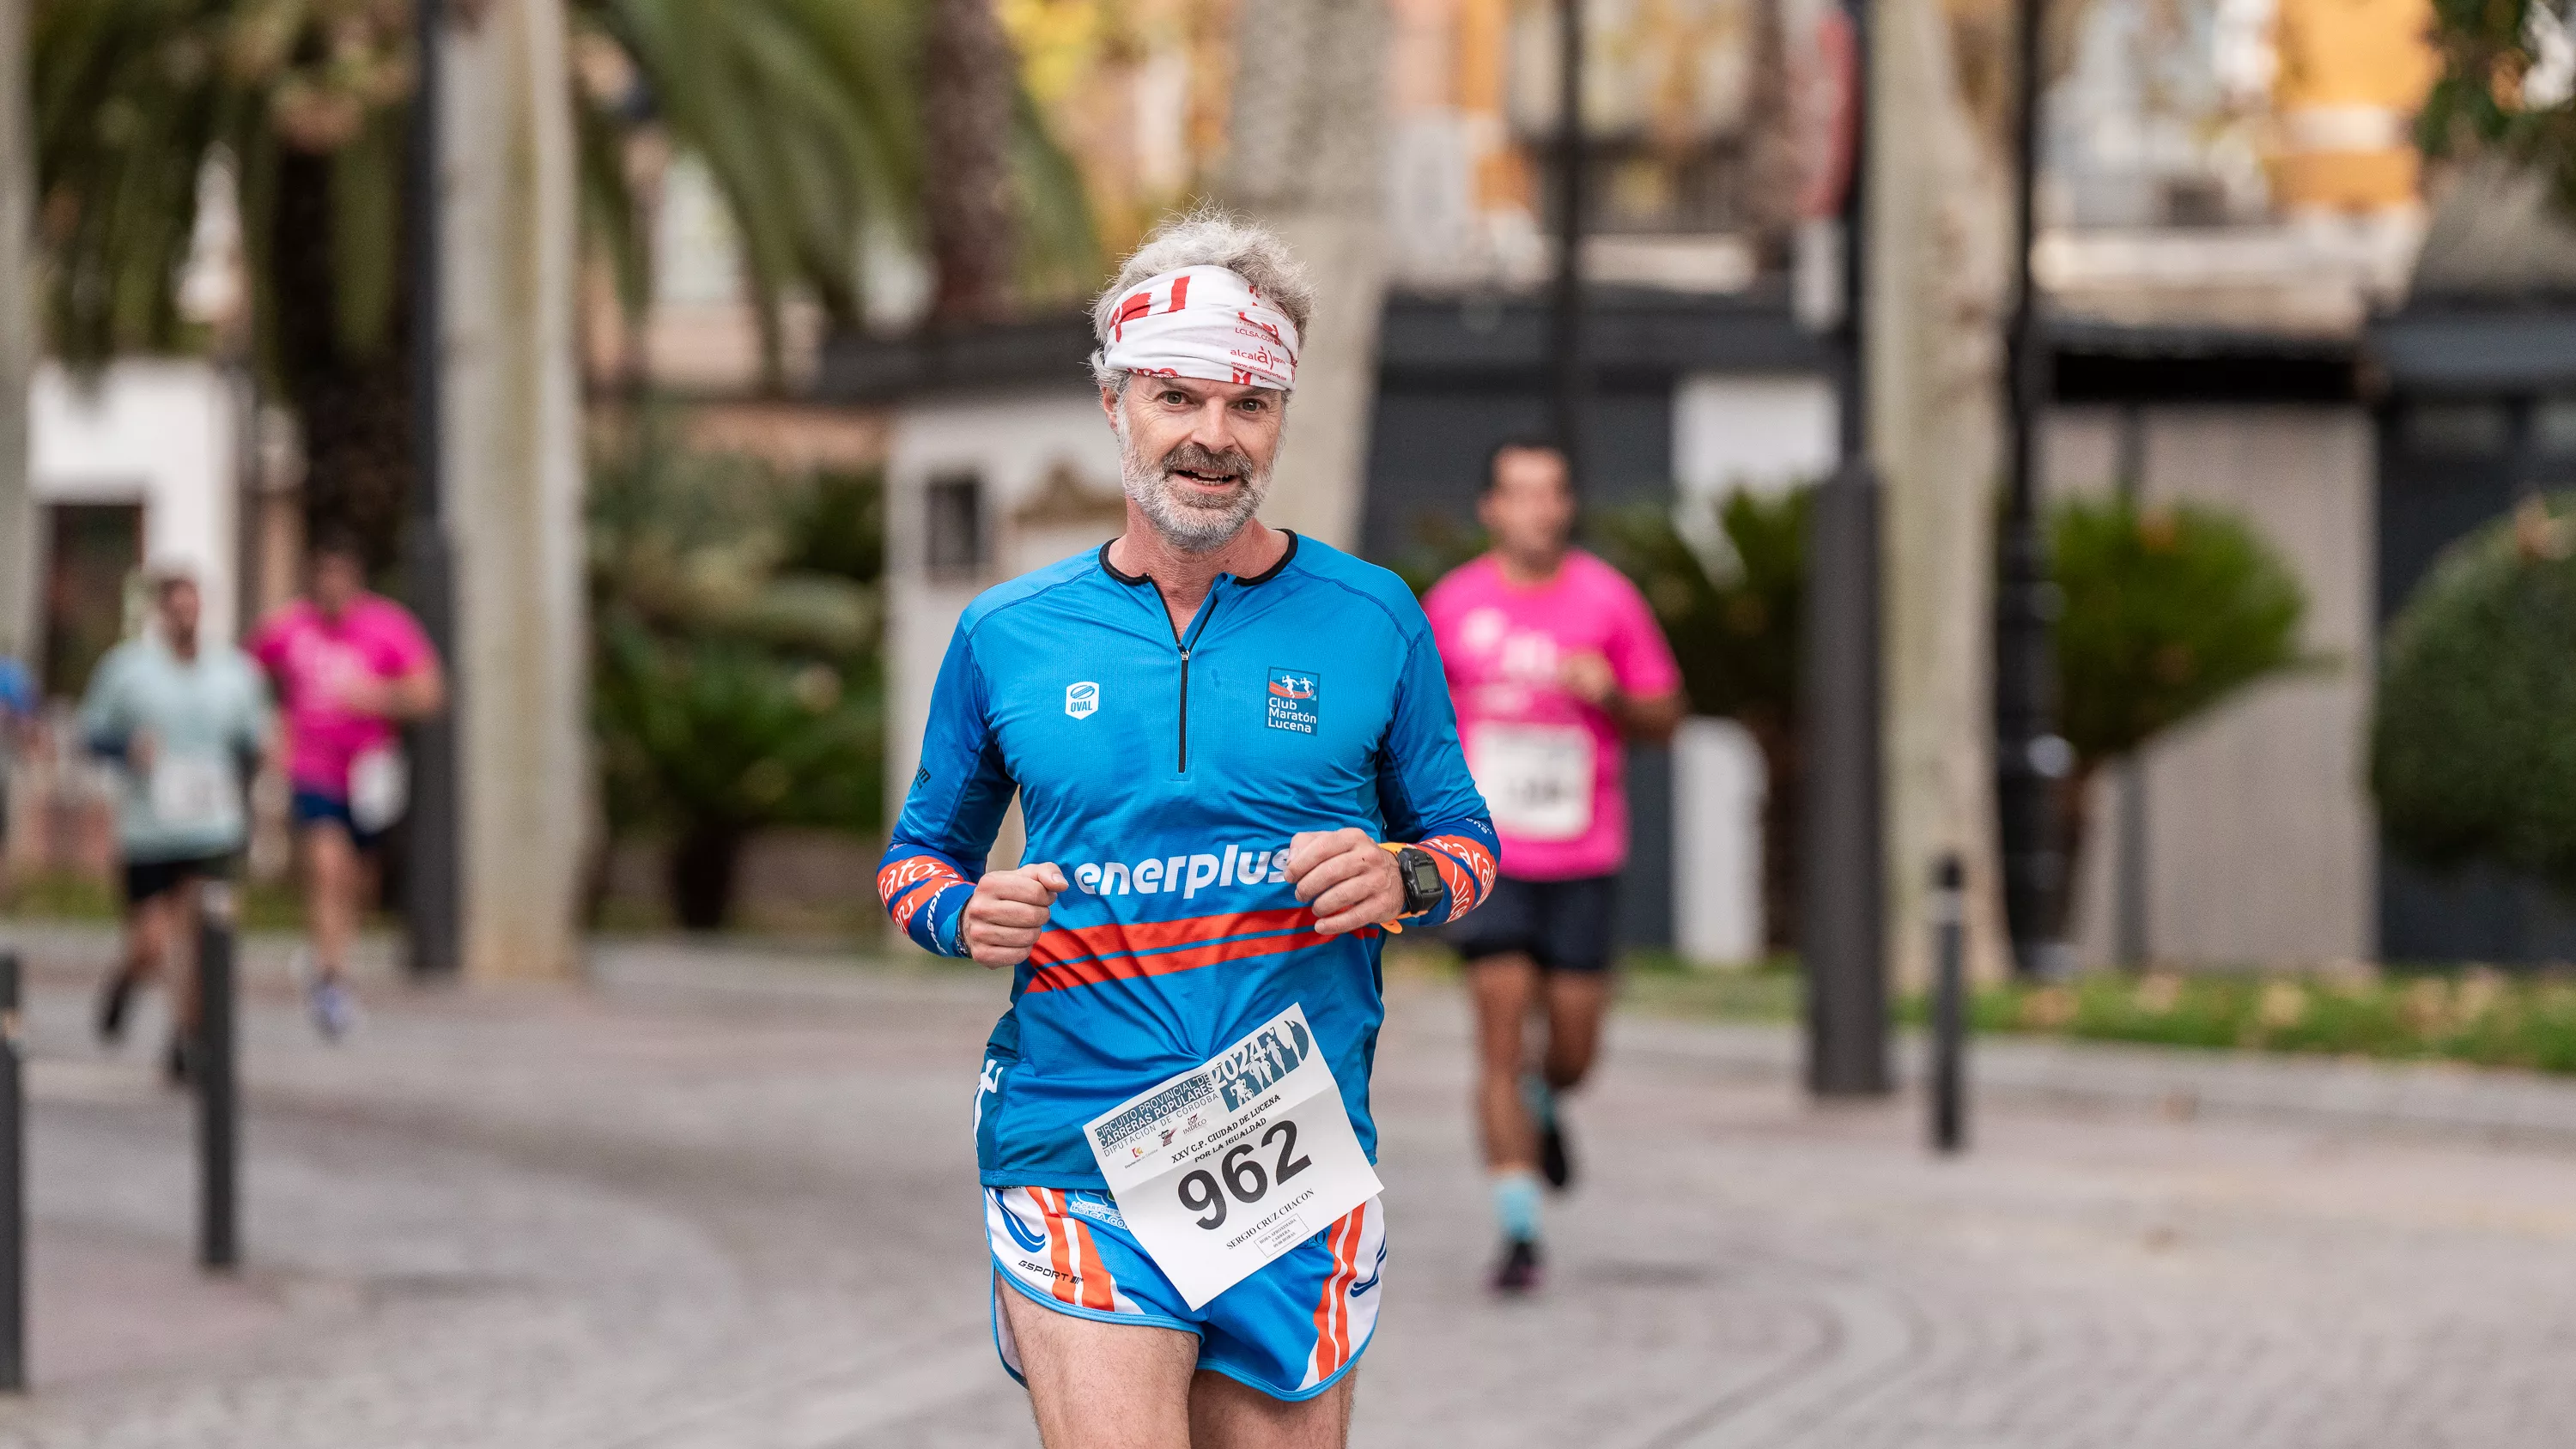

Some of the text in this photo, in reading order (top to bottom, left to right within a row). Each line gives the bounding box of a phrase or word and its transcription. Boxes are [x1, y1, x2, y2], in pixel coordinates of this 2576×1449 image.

[1071, 700, 1092, 712] OVAL
[1268, 717, 1311, 733] Lucena
[1269, 697, 1297, 710] Club
[1269, 707, 1316, 724] Maratón
[1074, 845, 1291, 899] enerplus
[1211, 1042, 1267, 1087] 2024
[1096, 1073, 1210, 1139] CIRCUITO PROVINCIAL DE
[1099, 1082, 1214, 1149] CARRERAS POPULARES
[1103, 1093, 1219, 1157] DIPUTACIÓN DE CÓRDOBA
[1183, 1119, 1207, 1135] IMDECO
[1171, 1094, 1281, 1163] XXV C.P. CIUDAD DE LUCENA
[1194, 1118, 1267, 1162] POR LA IGUALDAD
[1178, 1120, 1312, 1230] 962
[1226, 1188, 1315, 1250] SERGIO CRUZ CHACON
[1271, 1218, 1297, 1238] APROXIMADA
[1272, 1229, 1291, 1243] CARRERA
[1018, 1259, 1068, 1282] GSPORT
